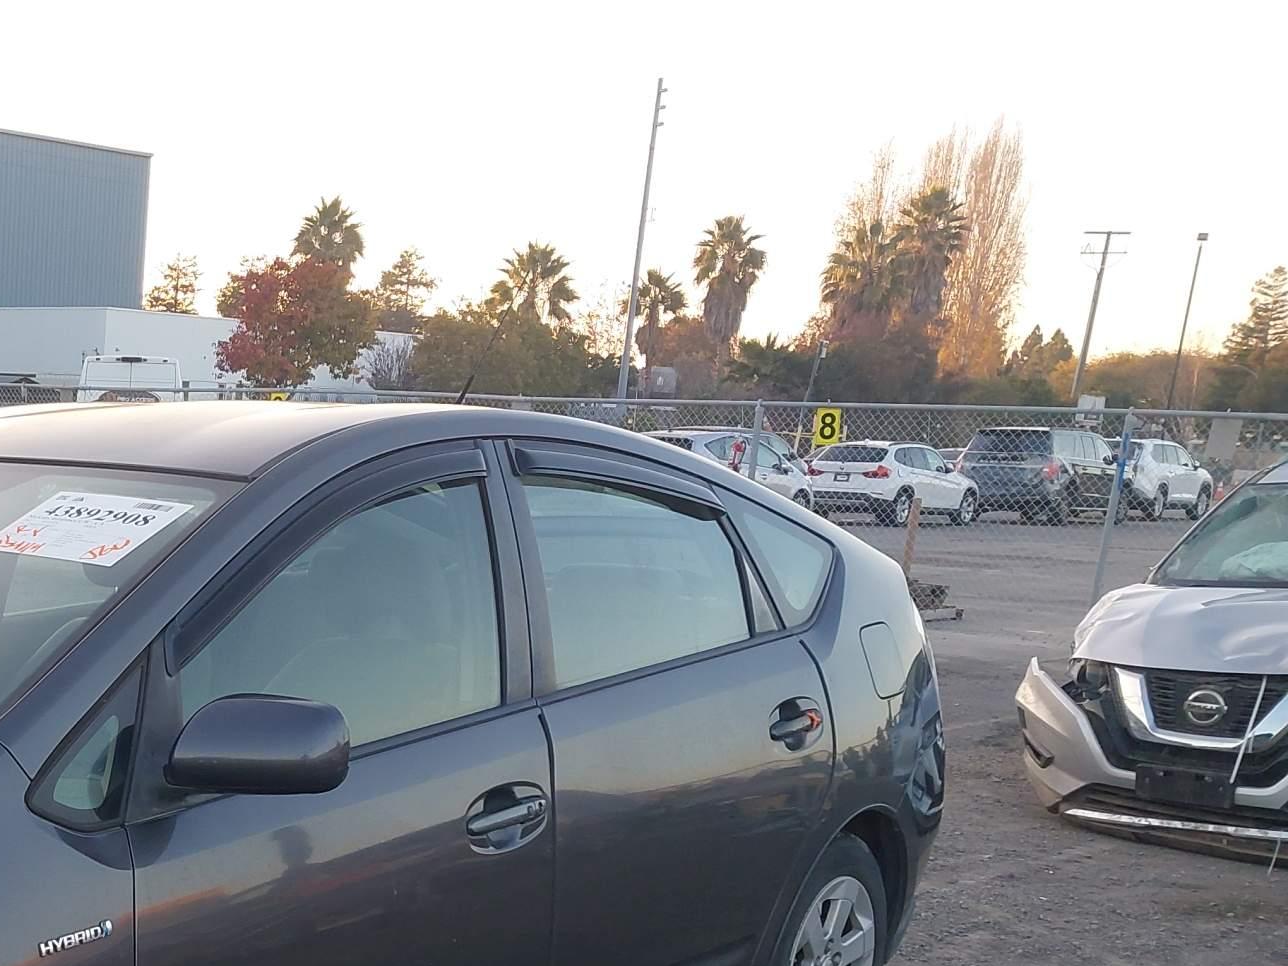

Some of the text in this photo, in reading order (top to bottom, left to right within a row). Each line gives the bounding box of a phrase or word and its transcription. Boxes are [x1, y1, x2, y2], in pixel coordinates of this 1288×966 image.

[819, 412, 837, 440] 8
[44, 504, 156, 527] 43892908
[38, 925, 102, 957] HYBRID
